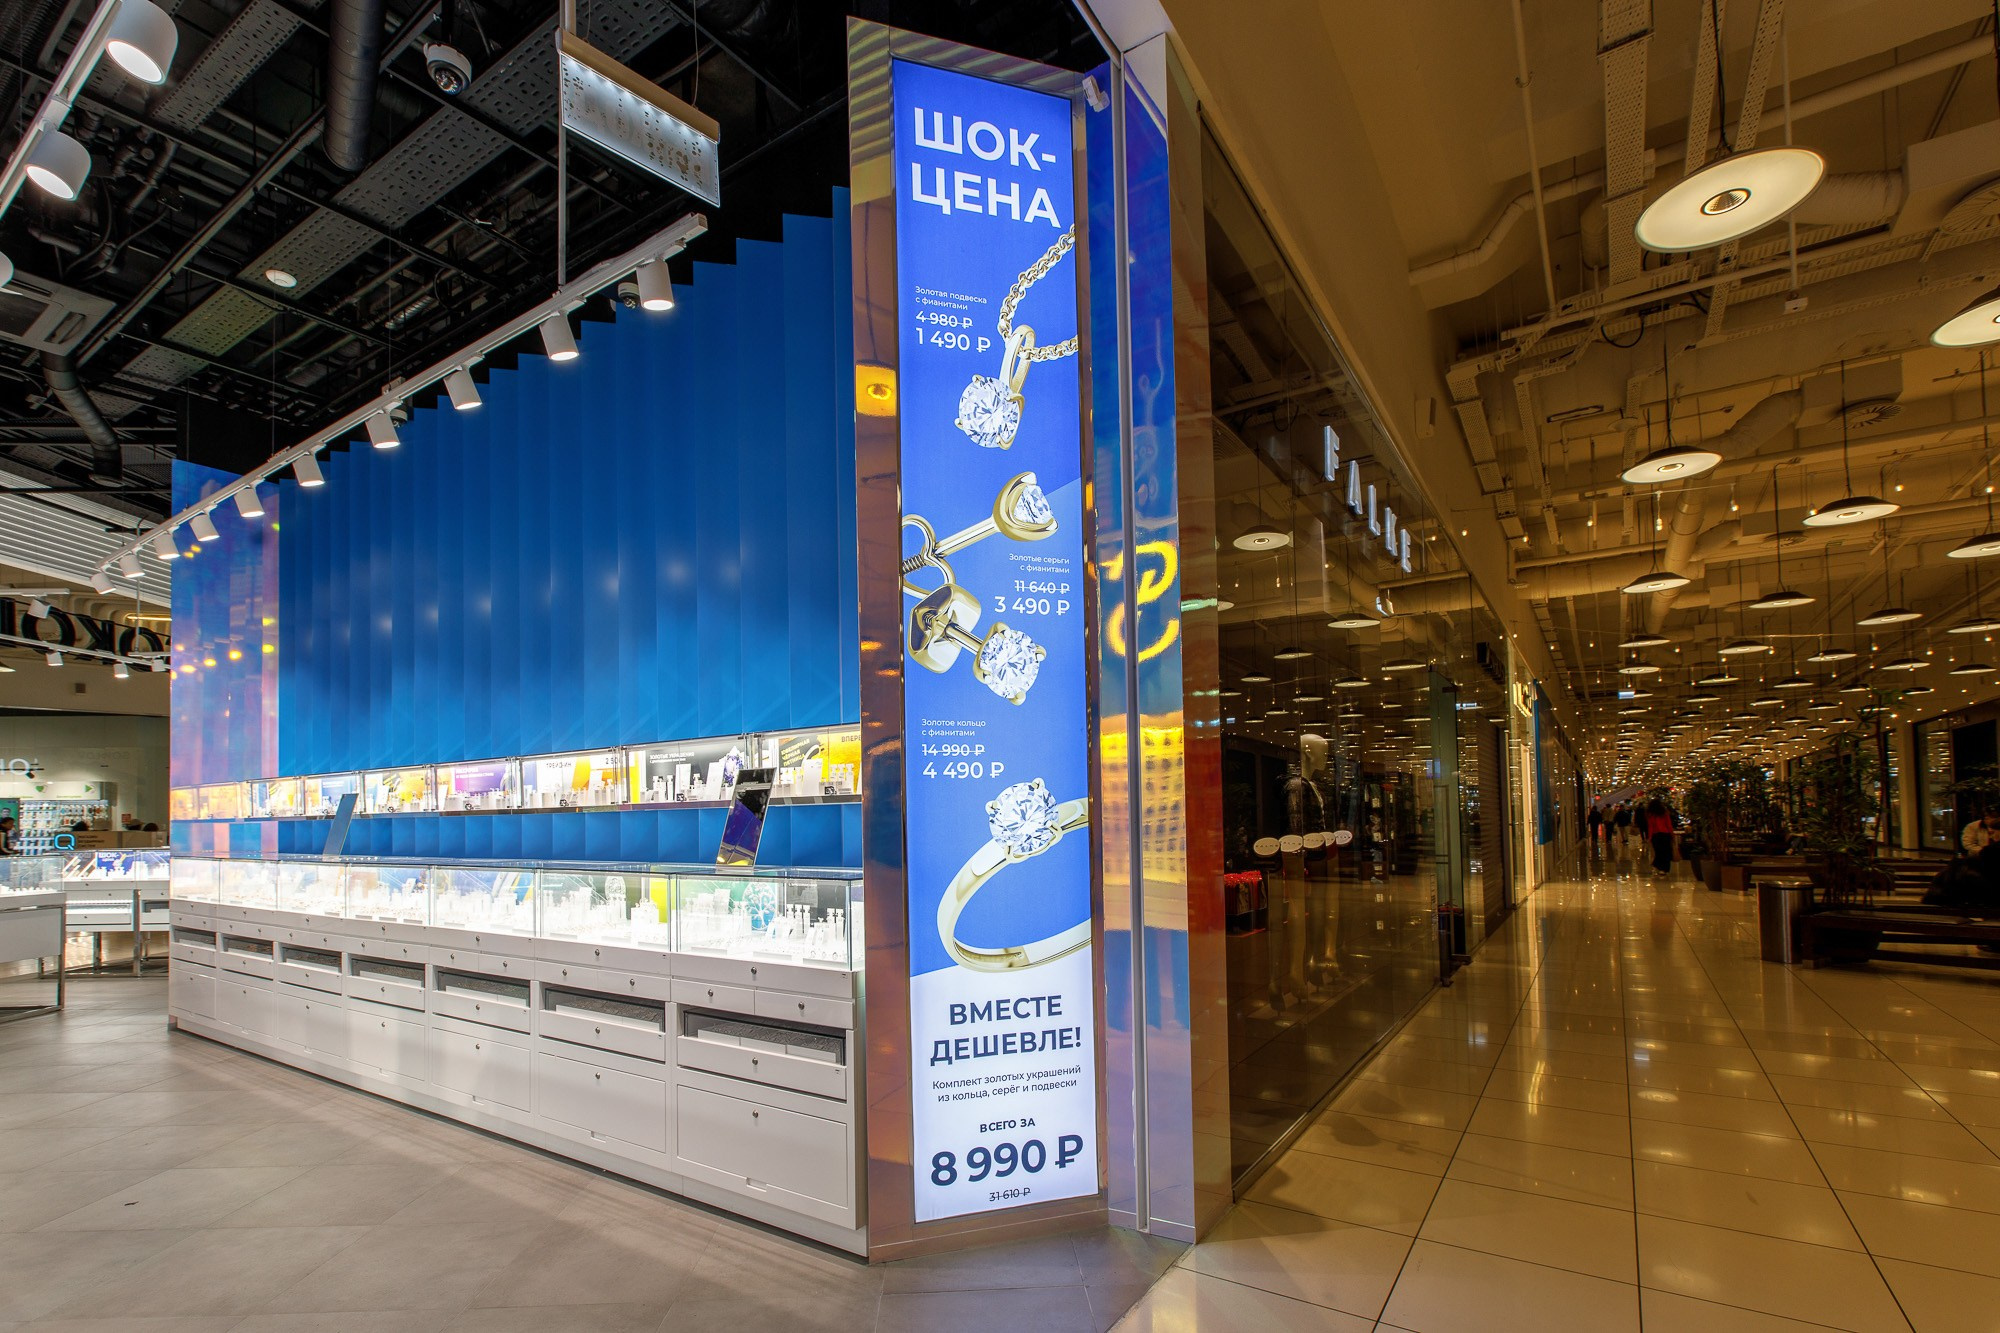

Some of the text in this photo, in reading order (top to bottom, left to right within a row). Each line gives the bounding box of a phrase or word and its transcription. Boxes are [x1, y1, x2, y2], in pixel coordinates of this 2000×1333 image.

[915, 107, 1056, 171] ШОК-
[912, 162, 1061, 228] ЦЕНА
[916, 286, 987, 304] Золотая подвеска
[922, 297, 968, 310] фианитами
[916, 311, 926, 323] 4
[930, 312, 958, 327] 980
[916, 327, 923, 344] 1
[930, 330, 970, 351] 490
[1324, 425, 1412, 573] FALKE
[1009, 553, 1069, 565] Золотые серьги
[1026, 564, 1069, 573] фианитами
[1014, 580, 1025, 592] 11
[1029, 581, 1056, 594] 640
[994, 596, 1006, 613] 3
[1012, 597, 1050, 615] 490
[928, 729, 975, 737] фианитами
[922, 744, 938, 756] 14
[942, 744, 970, 756] 990
[923, 762, 937, 778] 4
[943, 762, 983, 779] 490
[950, 995, 1062, 1026] ВМЕСТЕ
[930, 1027, 1082, 1067] ДЕШЕВЛЕ!
[932, 1065, 1081, 1090] Комплект золотых украшений
[938, 1094, 950, 1102] из
[952, 1089, 990, 1101] кольца,
[992, 1084, 1020, 1098] серёг
[1031, 1079, 1077, 1092] подвески
[980, 1118, 1035, 1133] ВСЕГО ЗА
[931, 1134, 1084, 1186] 8 990 ₽
